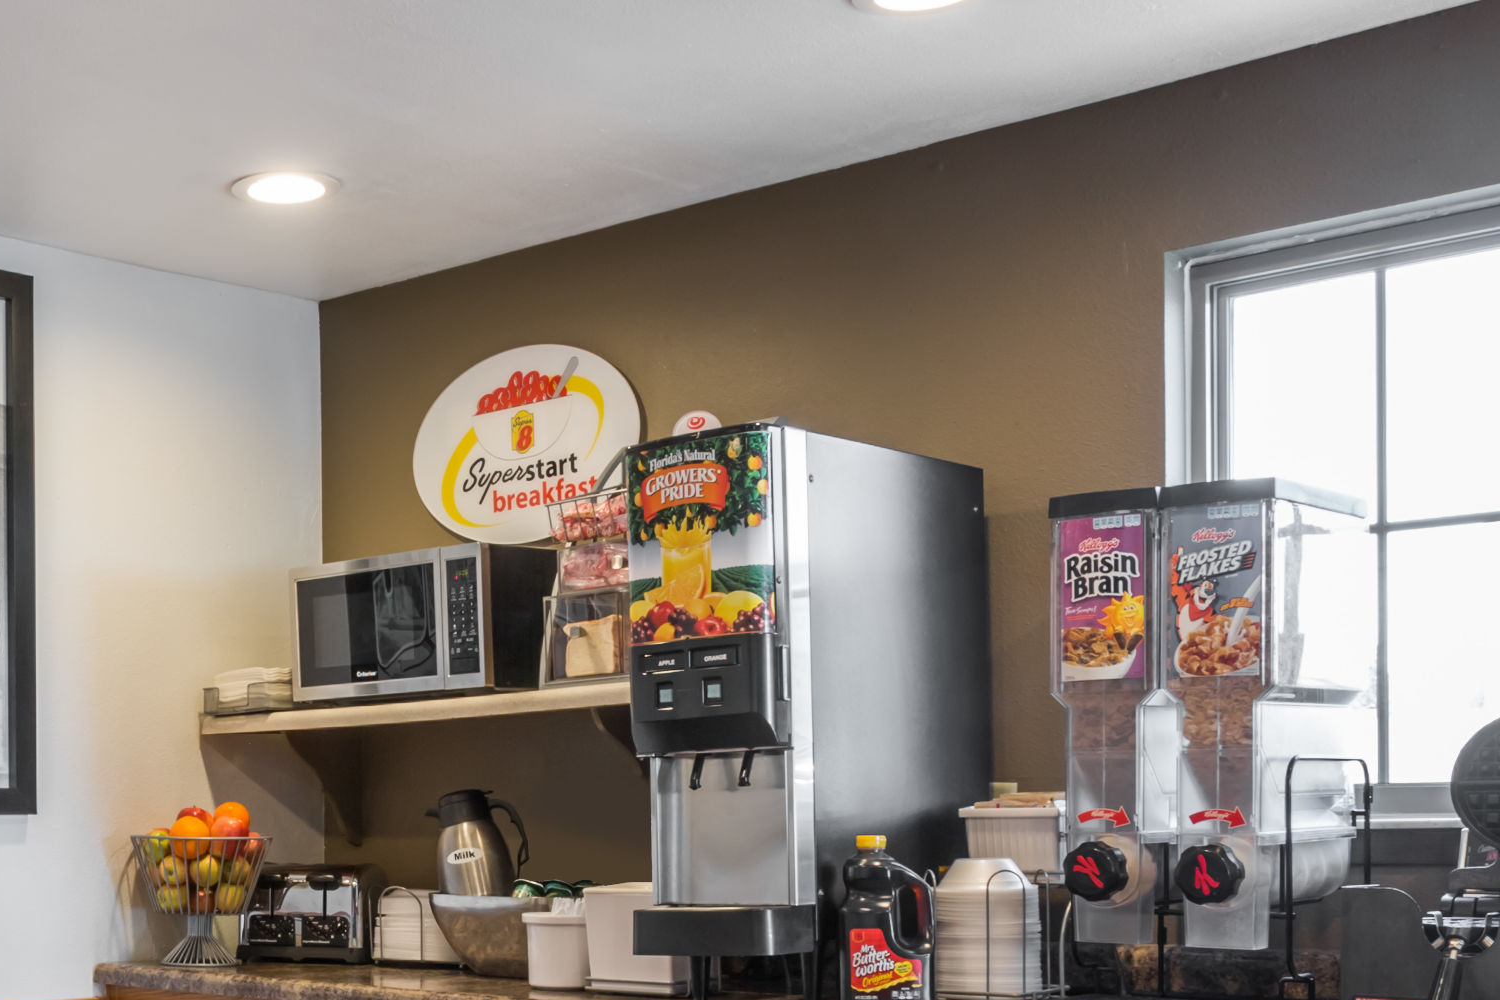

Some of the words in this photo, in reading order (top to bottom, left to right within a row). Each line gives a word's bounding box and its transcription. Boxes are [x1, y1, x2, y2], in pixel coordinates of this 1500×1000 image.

[513, 416, 532, 431] Super
[516, 425, 533, 451] 8
[649, 450, 682, 472] Florida's
[683, 447, 716, 461] Natural
[462, 452, 578, 505] Superstart
[493, 475, 597, 513] breakfast
[661, 483, 704, 504] PRIDE
[1079, 537, 1120, 552] Kellogg's
[1192, 528, 1236, 543] Kellogg's
[1065, 552, 1139, 582] Raisin
[1177, 540, 1252, 571] FROSTED
[1179, 556, 1242, 584] FLAKES
[1072, 575, 1130, 601] Bran
[658, 659, 675, 667] APPLE
[704, 653, 727, 662] ORANGE
[454, 850, 475, 860] Milk
[852, 950, 890, 968] Butter-
[855, 958, 895, 977] worth's
